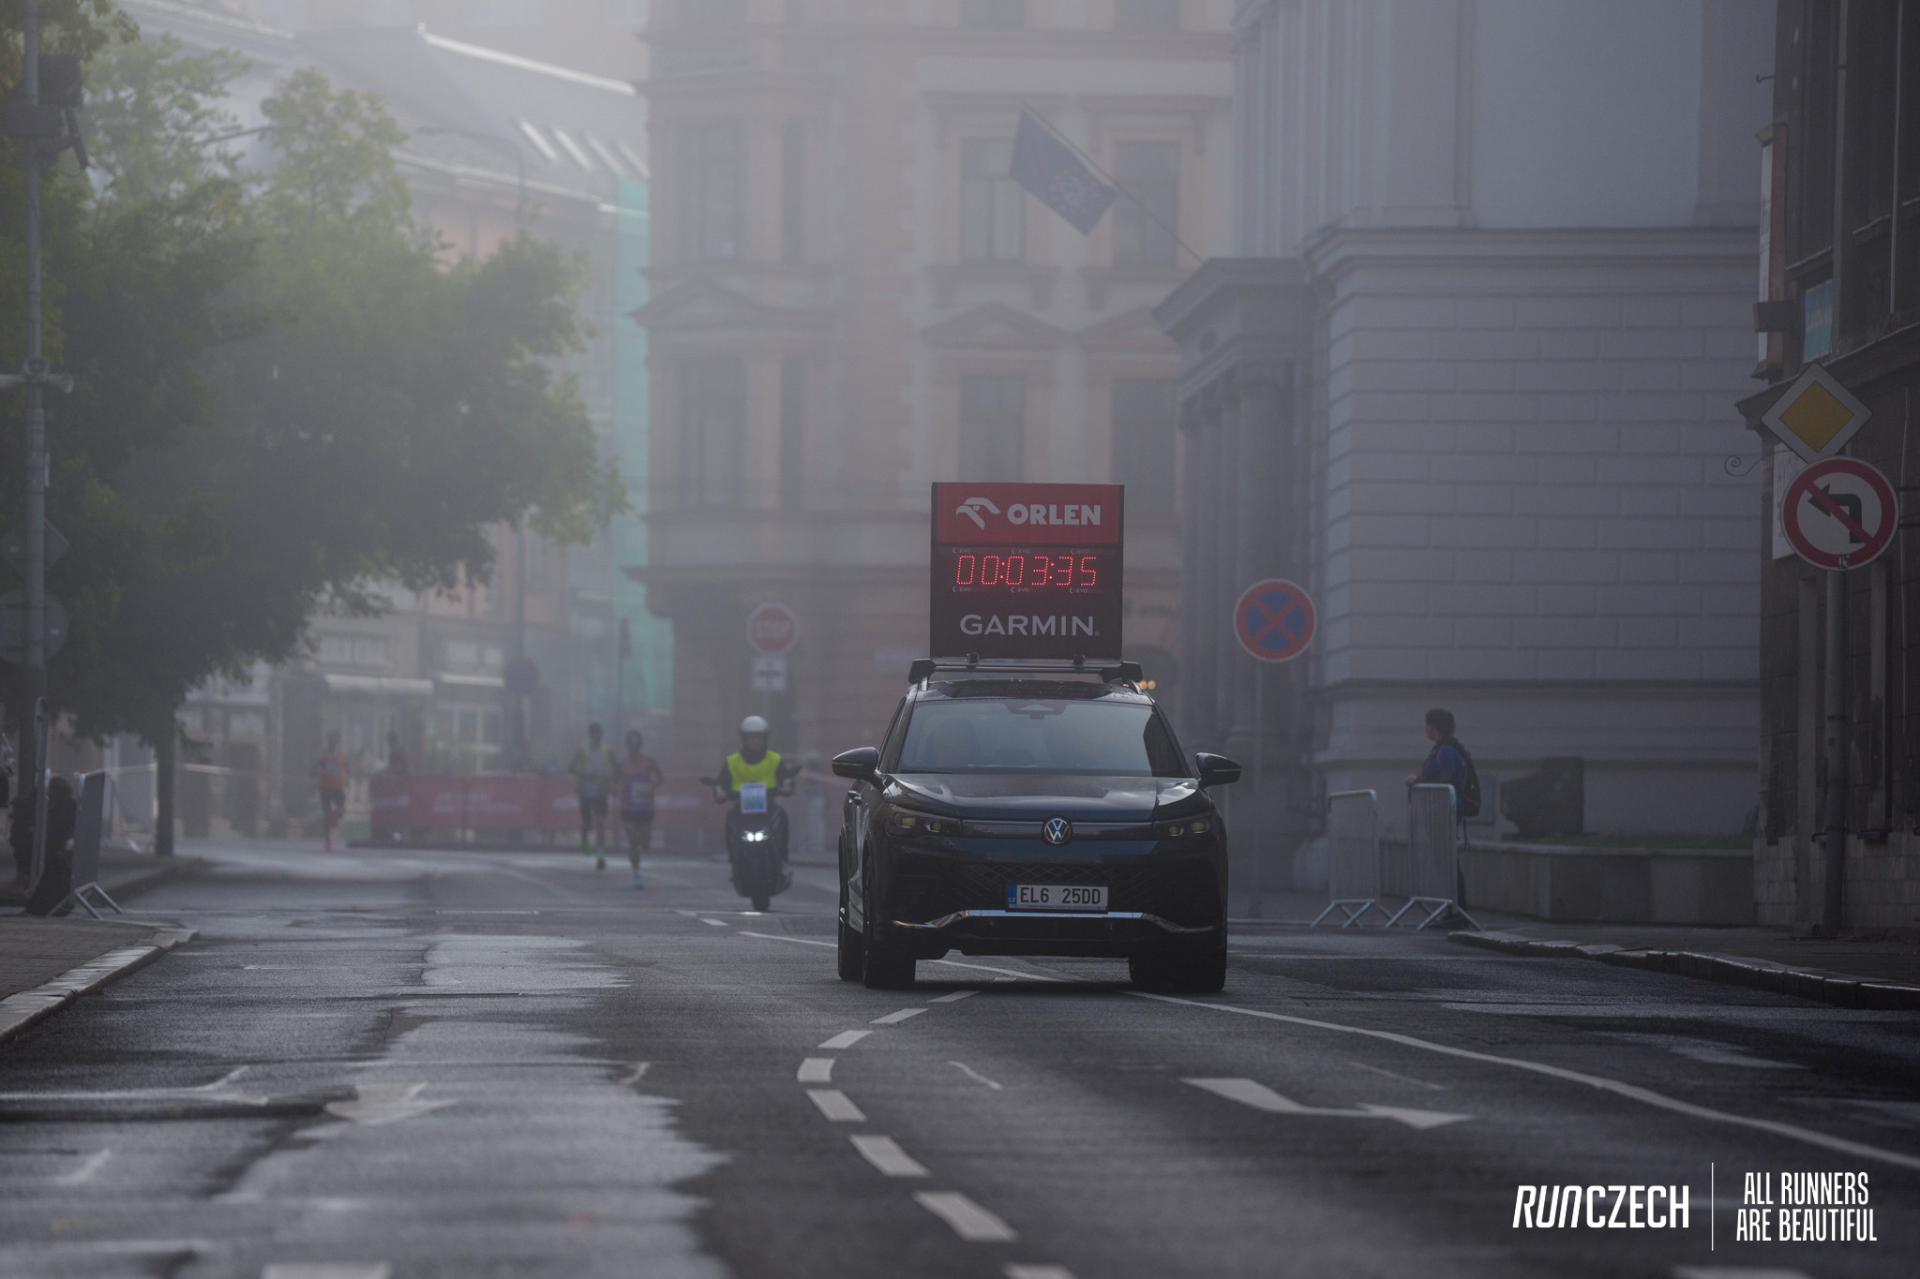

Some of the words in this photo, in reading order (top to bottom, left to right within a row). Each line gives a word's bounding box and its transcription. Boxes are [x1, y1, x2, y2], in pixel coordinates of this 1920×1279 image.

[1007, 503, 1101, 526] ORLEN
[956, 555, 1097, 587] 00:03:35
[959, 613, 1094, 637] GARMIN
[1020, 887, 1049, 903] EL6
[1062, 888, 1101, 904] 25DD
